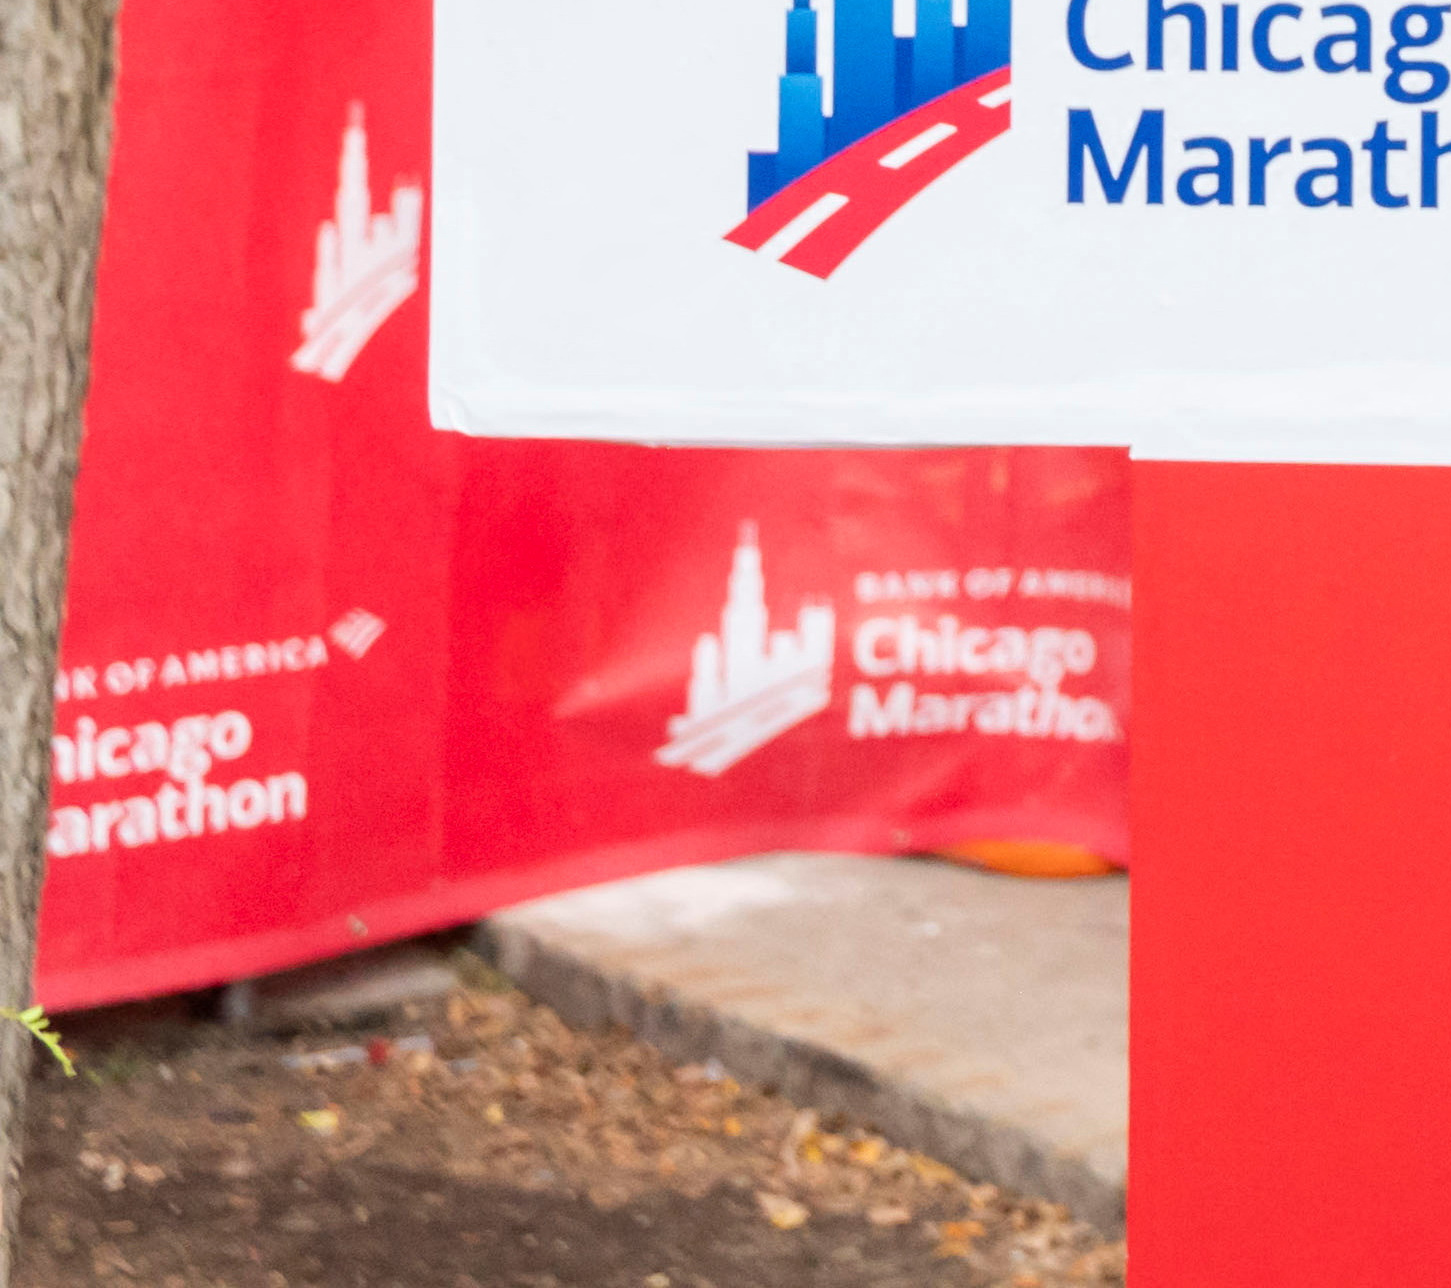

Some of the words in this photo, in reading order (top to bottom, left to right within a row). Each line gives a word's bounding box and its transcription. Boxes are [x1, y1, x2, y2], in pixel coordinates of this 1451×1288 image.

[854, 570, 958, 605] BANK
[963, 566, 1016, 601] OF
[104, 657, 158, 696] OF
[159, 635, 330, 689] AMERICA
[852, 613, 1098, 689] Chicago
[847, 680, 1128, 745] Maratho
[46, 770, 309, 858] arathon
